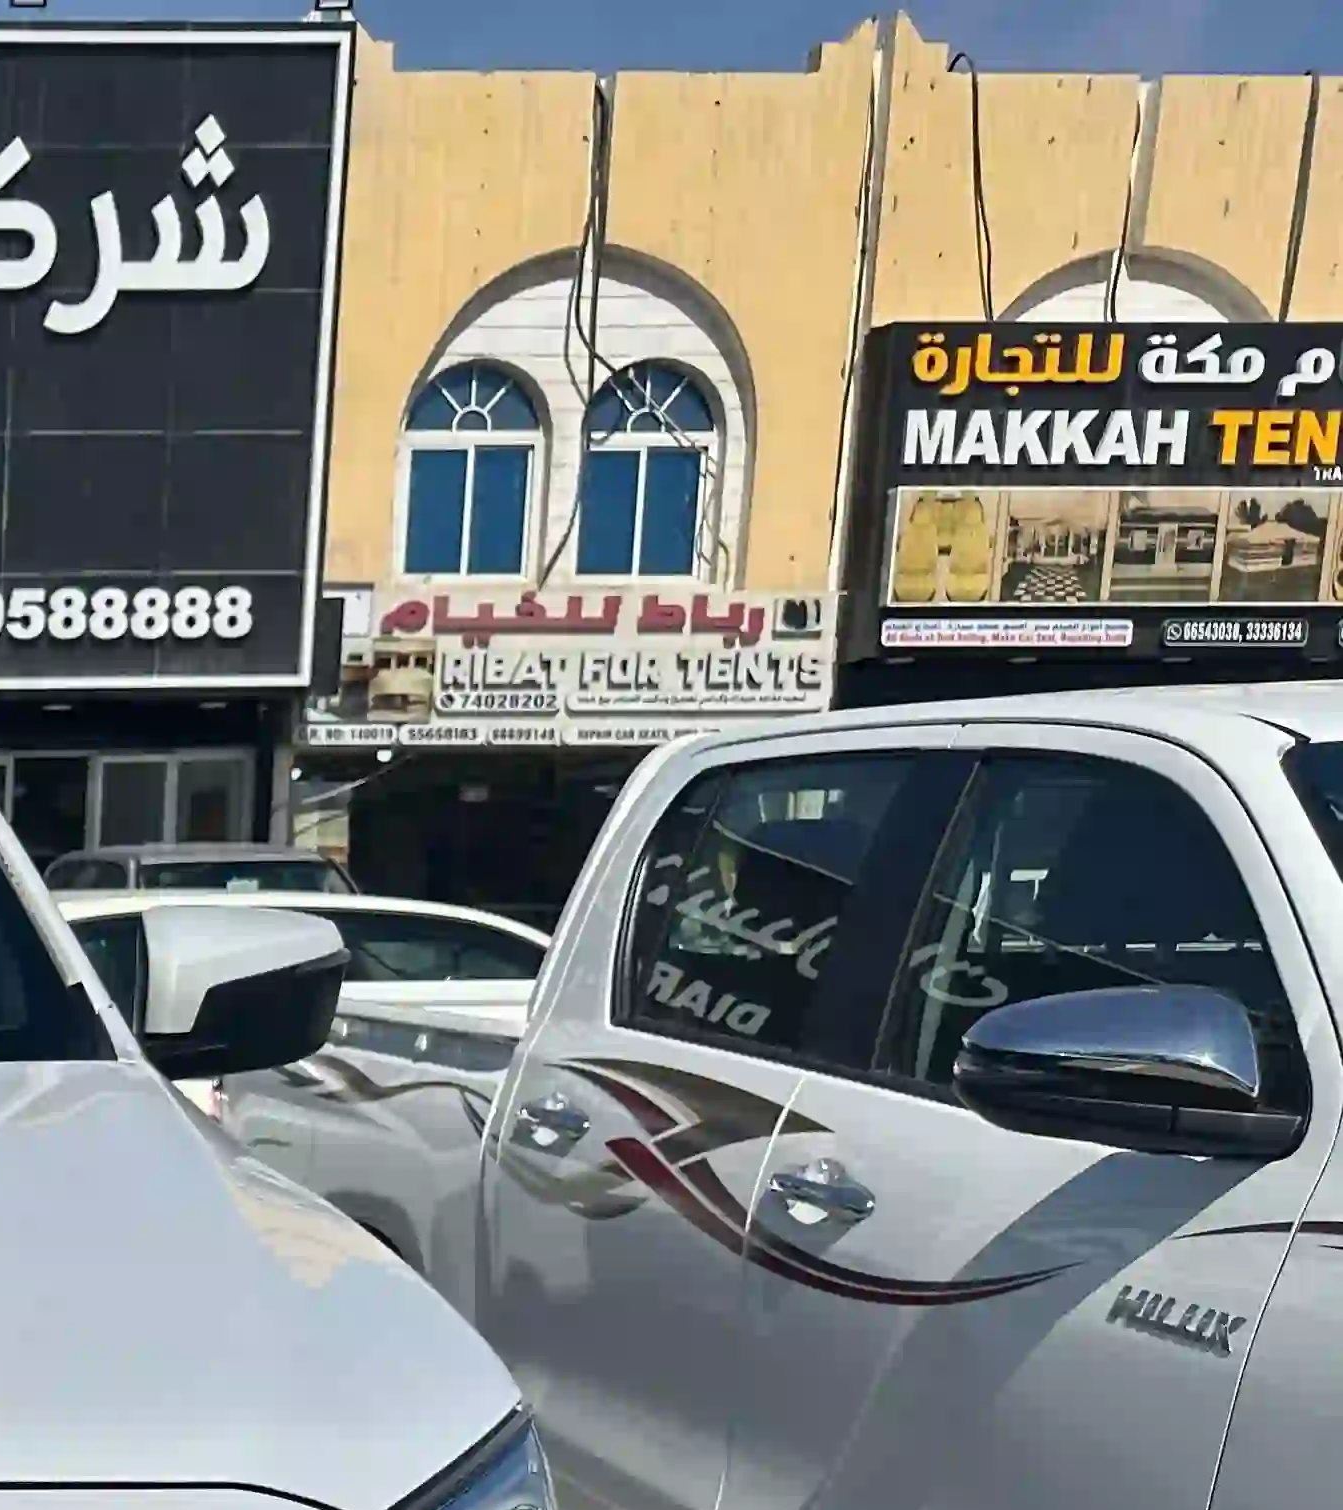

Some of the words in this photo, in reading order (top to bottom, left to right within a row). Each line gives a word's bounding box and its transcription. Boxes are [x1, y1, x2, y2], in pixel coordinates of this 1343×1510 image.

[911, 332, 1125, 396] للتجارة
[1138, 332, 1266, 384] مكة
[902, 408, 1191, 466] MAKKAH
[1212, 408, 1339, 466] TEN
[379, 591, 623, 650] للخيام
[637, 593, 767, 648] رباط
[440, 650, 567, 691] RIBAT
[578, 650, 663, 690] FOR
[675, 650, 824, 689] TENTS
